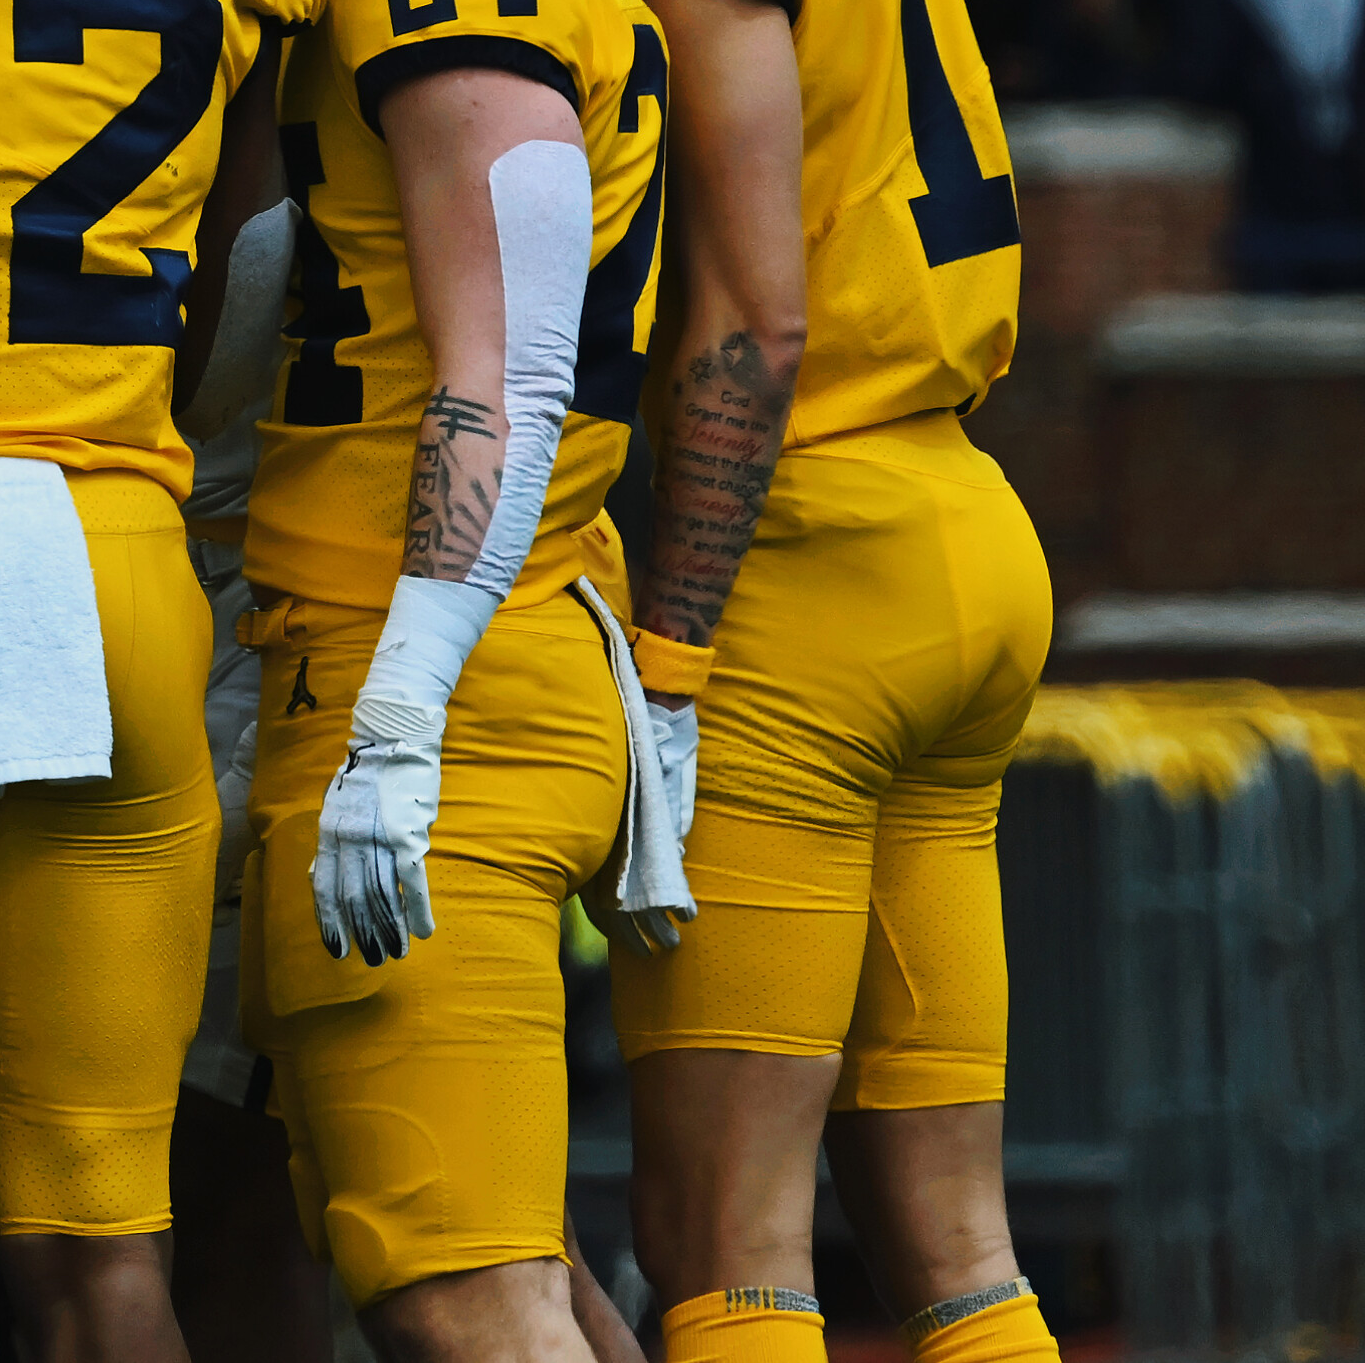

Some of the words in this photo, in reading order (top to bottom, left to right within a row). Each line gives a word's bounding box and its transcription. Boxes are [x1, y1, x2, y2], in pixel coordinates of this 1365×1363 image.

[721, 391, 750, 408] God
[686, 403, 723, 423] Grant
[726, 416, 747, 430] me
